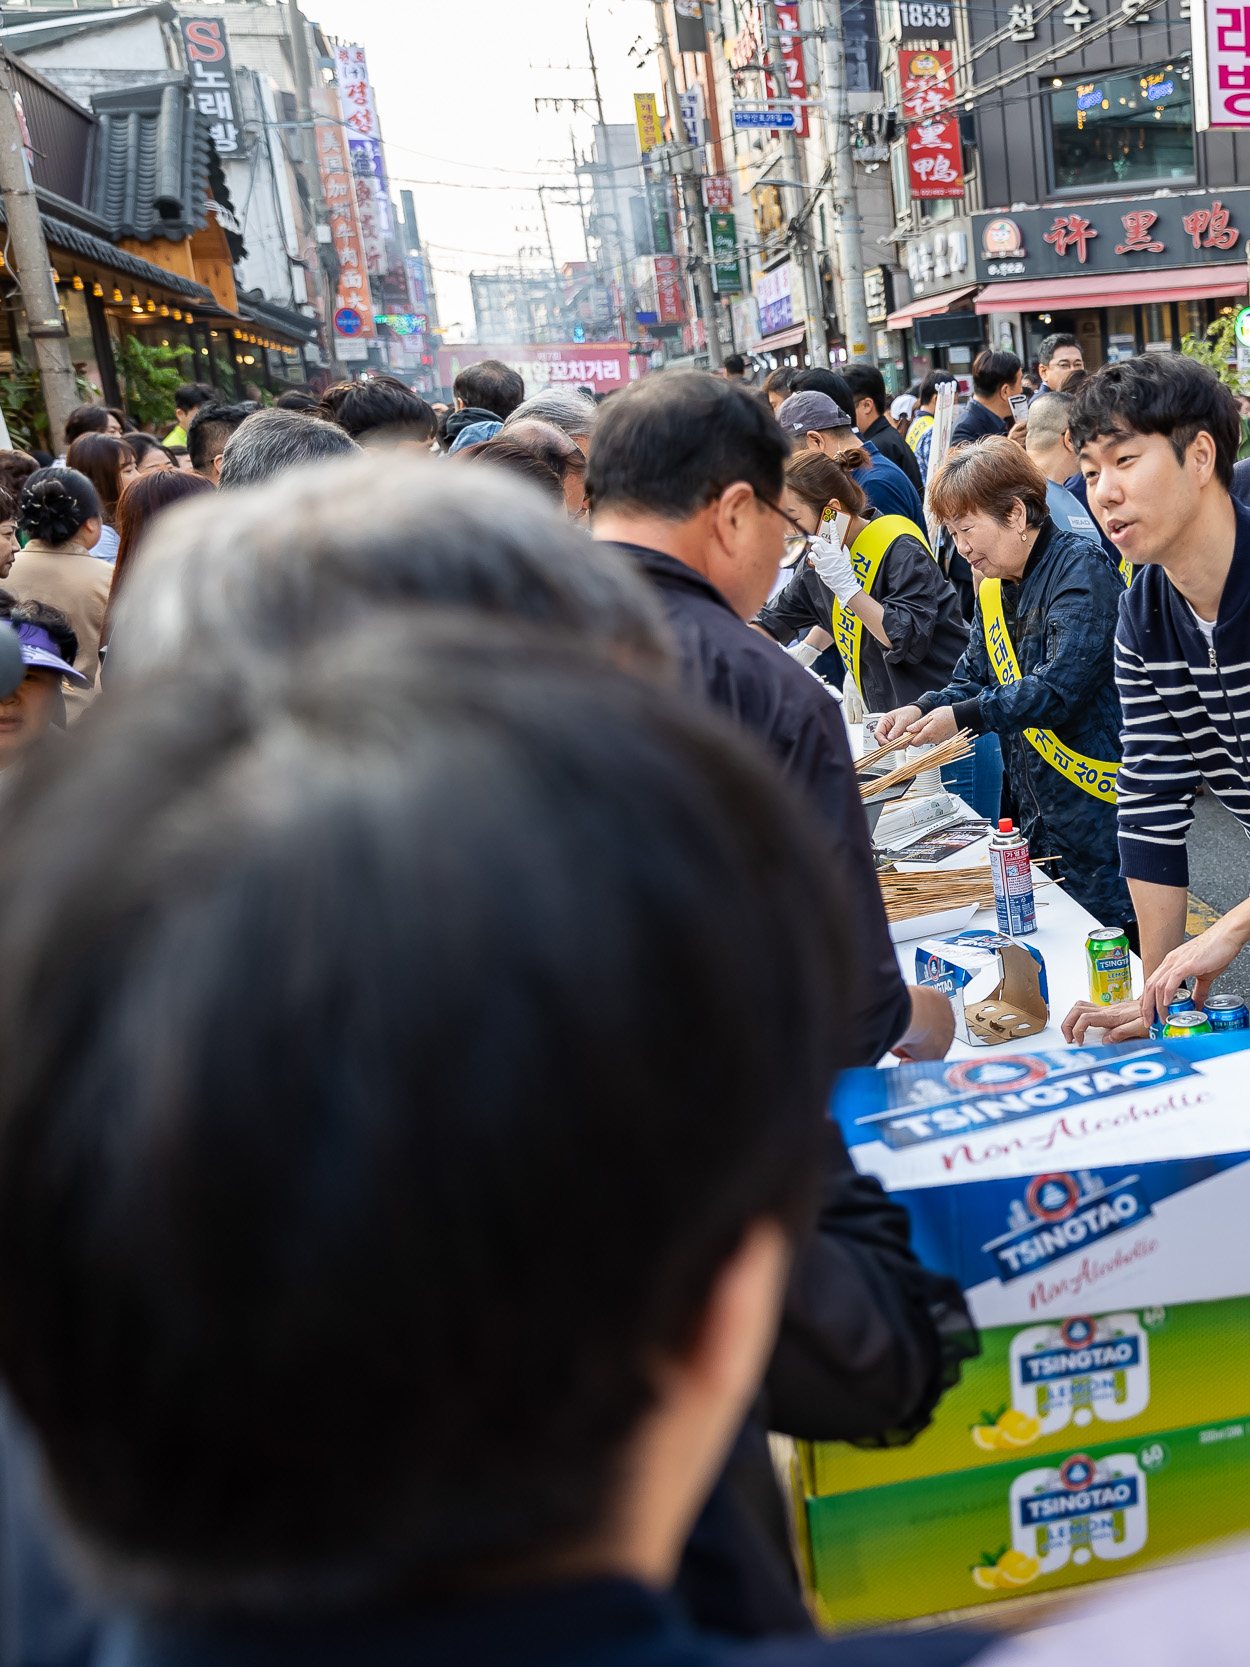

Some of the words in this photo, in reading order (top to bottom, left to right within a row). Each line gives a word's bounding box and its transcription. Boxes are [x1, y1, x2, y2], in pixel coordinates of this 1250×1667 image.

[901, 2, 950, 28] 1833
[187, 20, 226, 62] S
[192, 61, 240, 153] 노래방
[932, 979, 954, 994] NGTAO
[889, 1060, 1168, 1140] TSINGTAO
[999, 1193, 1140, 1272] TSINGTAO
[1026, 1342, 1133, 1379] TSINGTAO
[1047, 1378, 1115, 1400] LEMON
[1026, 1483, 1132, 1520] TSINGTAO
[1046, 1517, 1115, 1542] LEMON
